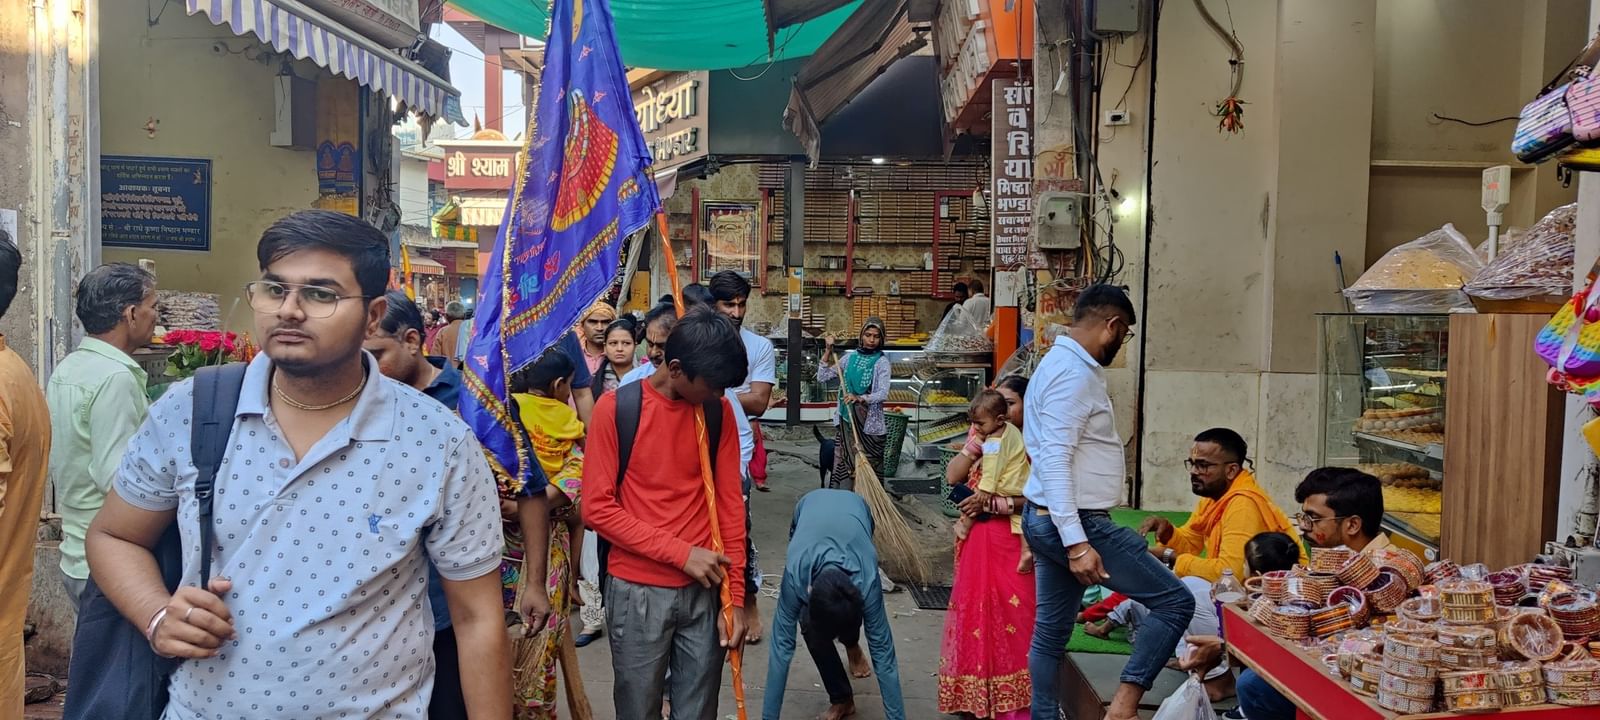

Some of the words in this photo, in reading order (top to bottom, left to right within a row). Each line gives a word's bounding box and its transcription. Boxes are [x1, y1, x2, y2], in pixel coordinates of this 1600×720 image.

[634, 80, 698, 133] योध्या
[447, 151, 466, 177] श्री
[471, 157, 510, 177] श्याम
[152, 185, 171, 194] सूचना
[997, 197, 1032, 212] भण्डा
